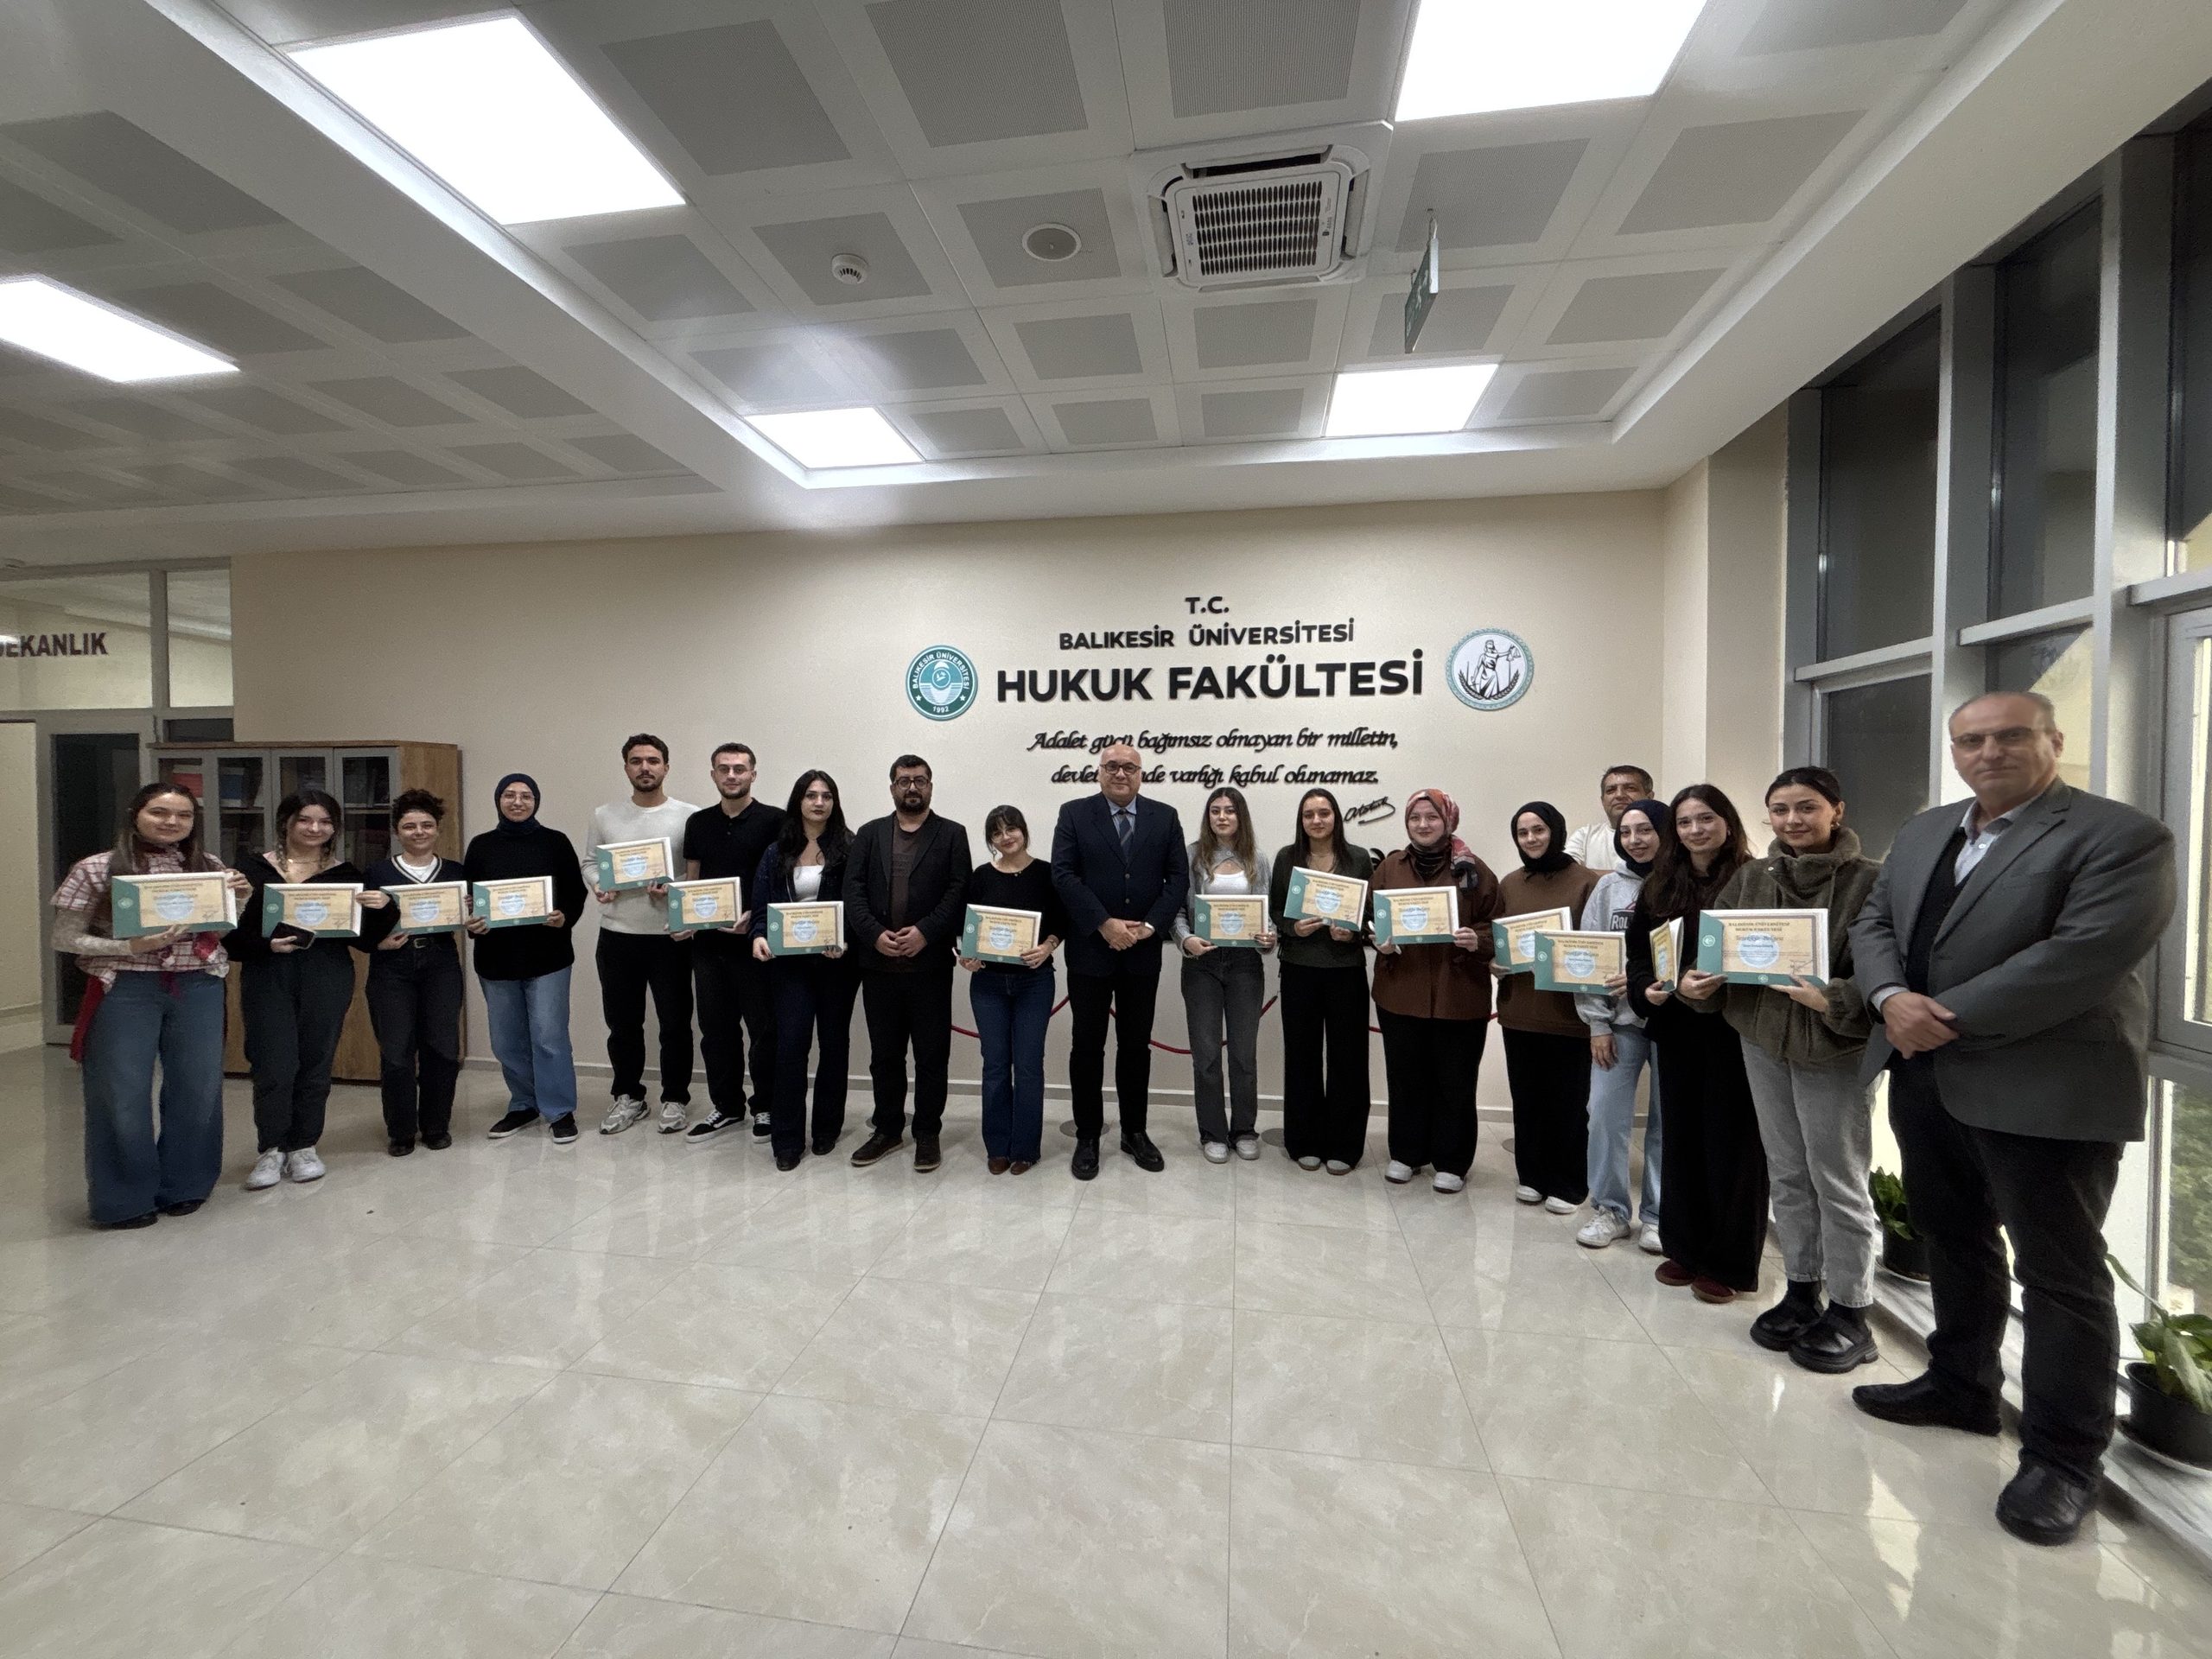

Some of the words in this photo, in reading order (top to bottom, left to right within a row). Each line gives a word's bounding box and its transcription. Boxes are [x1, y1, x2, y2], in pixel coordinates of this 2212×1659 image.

[1185, 596, 1230, 614] T.C.
[1059, 625, 1174, 650] BALIKESİR
[1189, 617, 1355, 647] ÜNİVERSİTESİ
[997, 668, 1154, 702] HUKUK
[1169, 648, 1424, 700] FAKÜLTESİ
[1027, 730, 1087, 752] Adalet
[1137, 730, 1211, 753] bağımsız
[1216, 728, 1293, 753] olmayan
[1296, 728, 1322, 747] bir
[1169, 764, 1224, 789] varlığı
[1229, 765, 1284, 787] kabul
